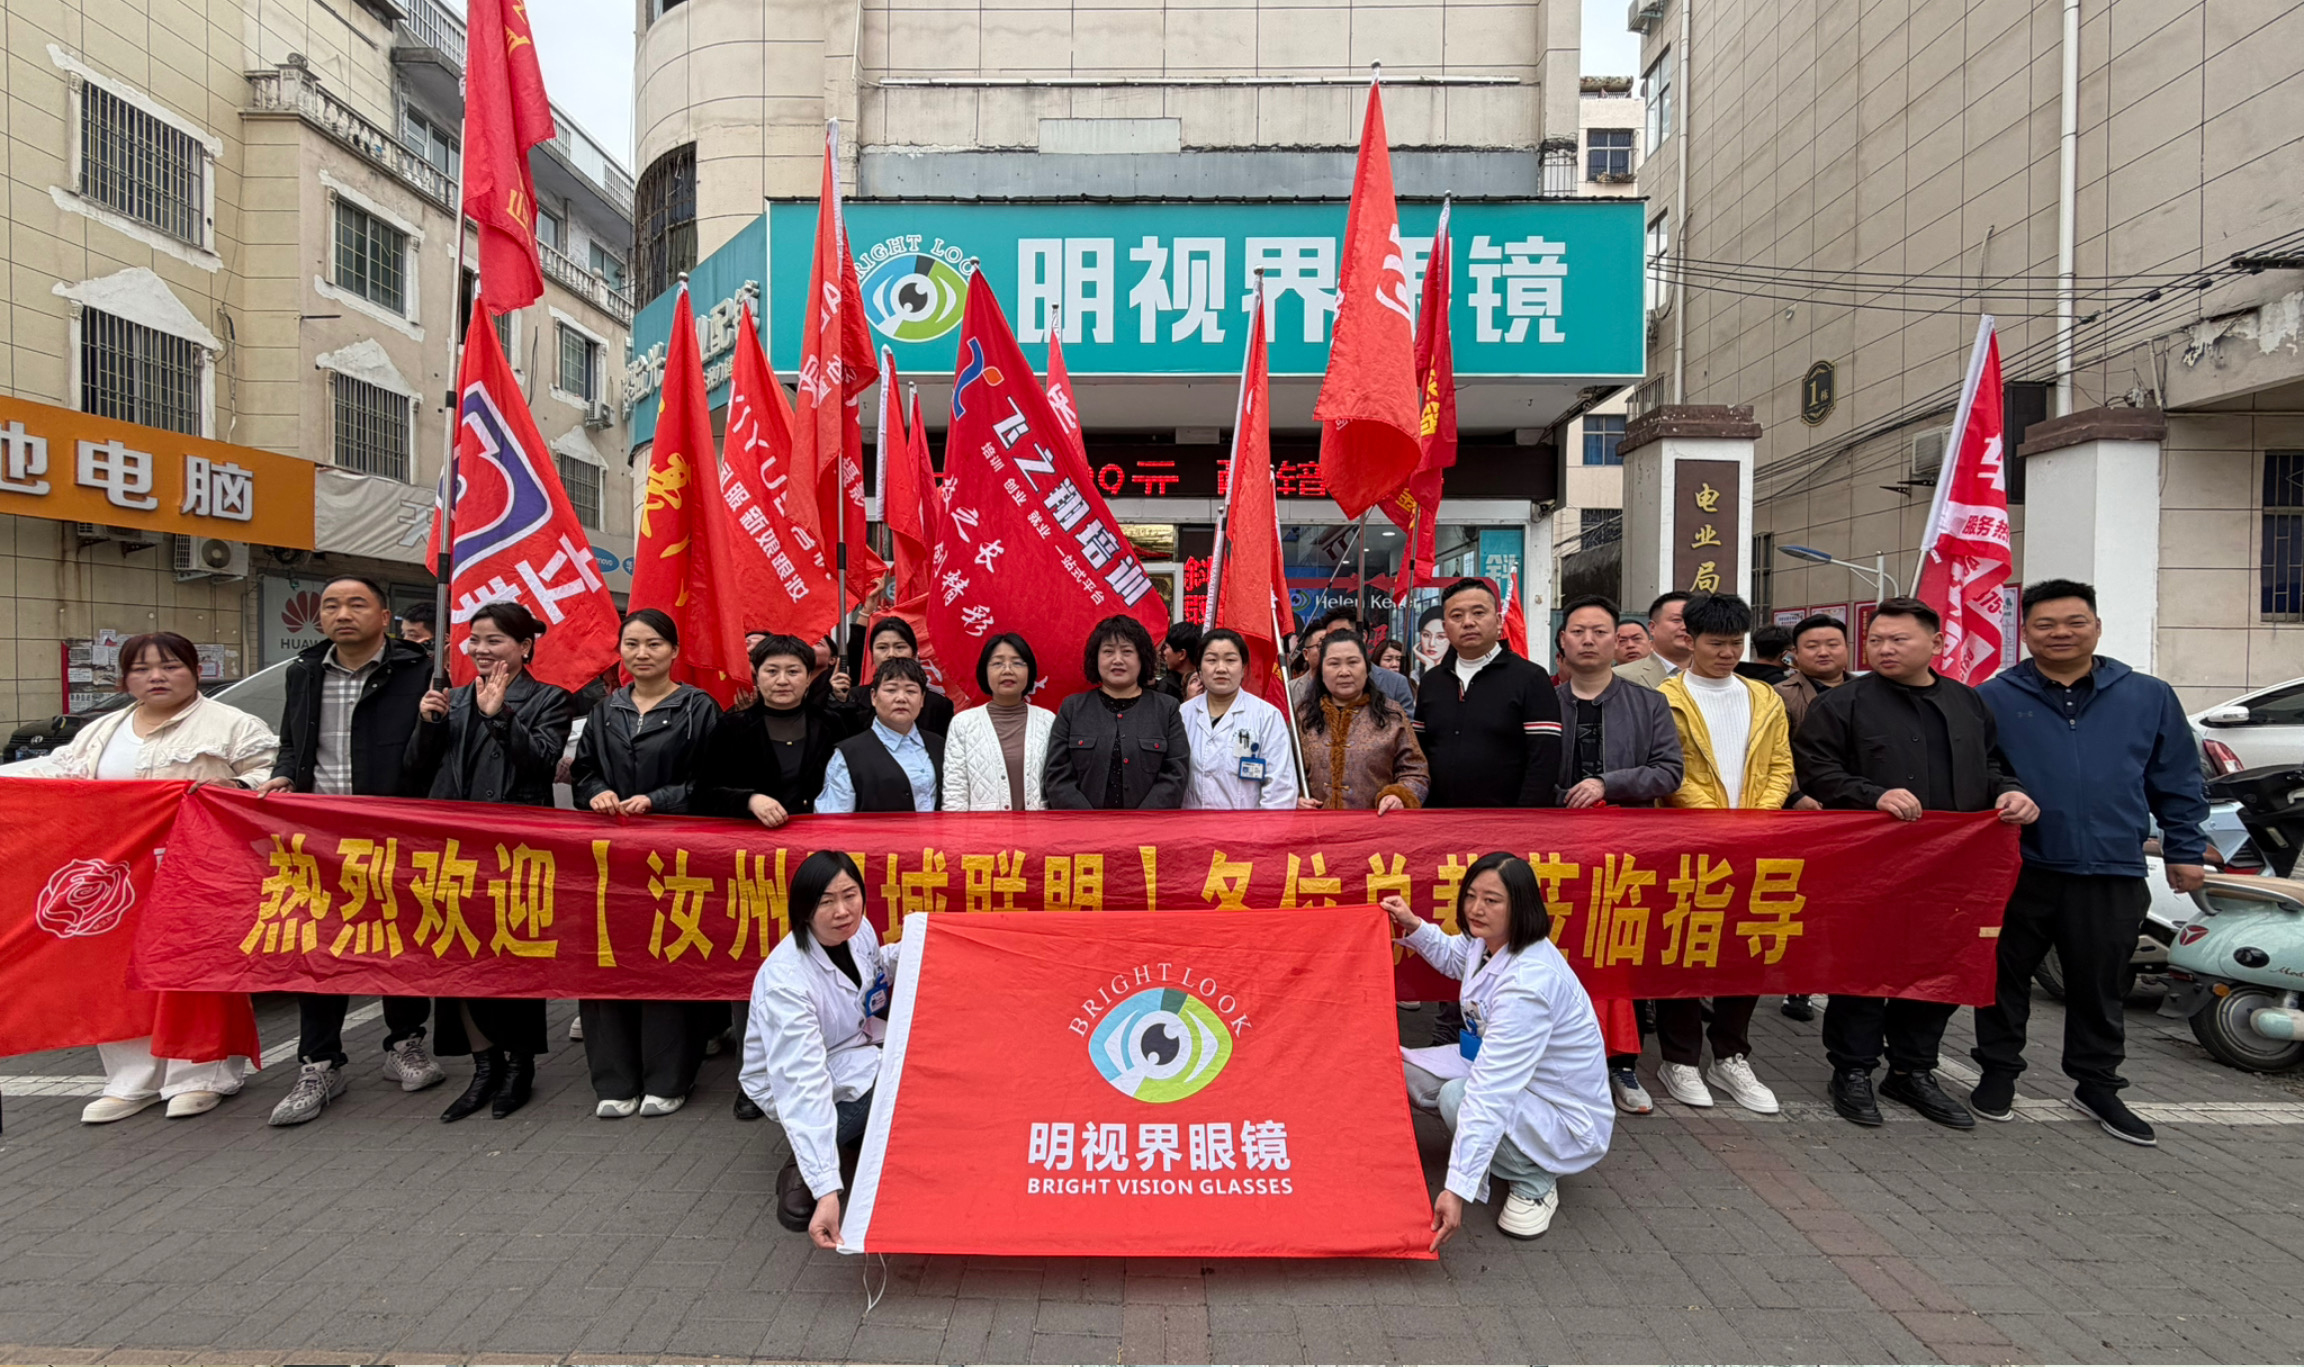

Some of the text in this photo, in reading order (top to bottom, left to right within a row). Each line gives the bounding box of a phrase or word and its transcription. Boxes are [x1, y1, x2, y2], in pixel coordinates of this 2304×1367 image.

[930, 238, 976, 283] LOO
[981, 441, 1106, 605] 培训 创业 就业 一站式平台
[992, 396, 1152, 608] 飞之翔培训
[1689, 482, 1722, 594] 电业局
[738, 503, 810, 604] 新娘跟妆
[1315, 594, 1365, 609] Helen
[1069, 962, 1252, 1038] BRIGHT LOOK
[1027, 1120, 1292, 1172] 明视界眼镜
[1027, 1178, 1294, 1195] BRIGHT VISION GLASSES
